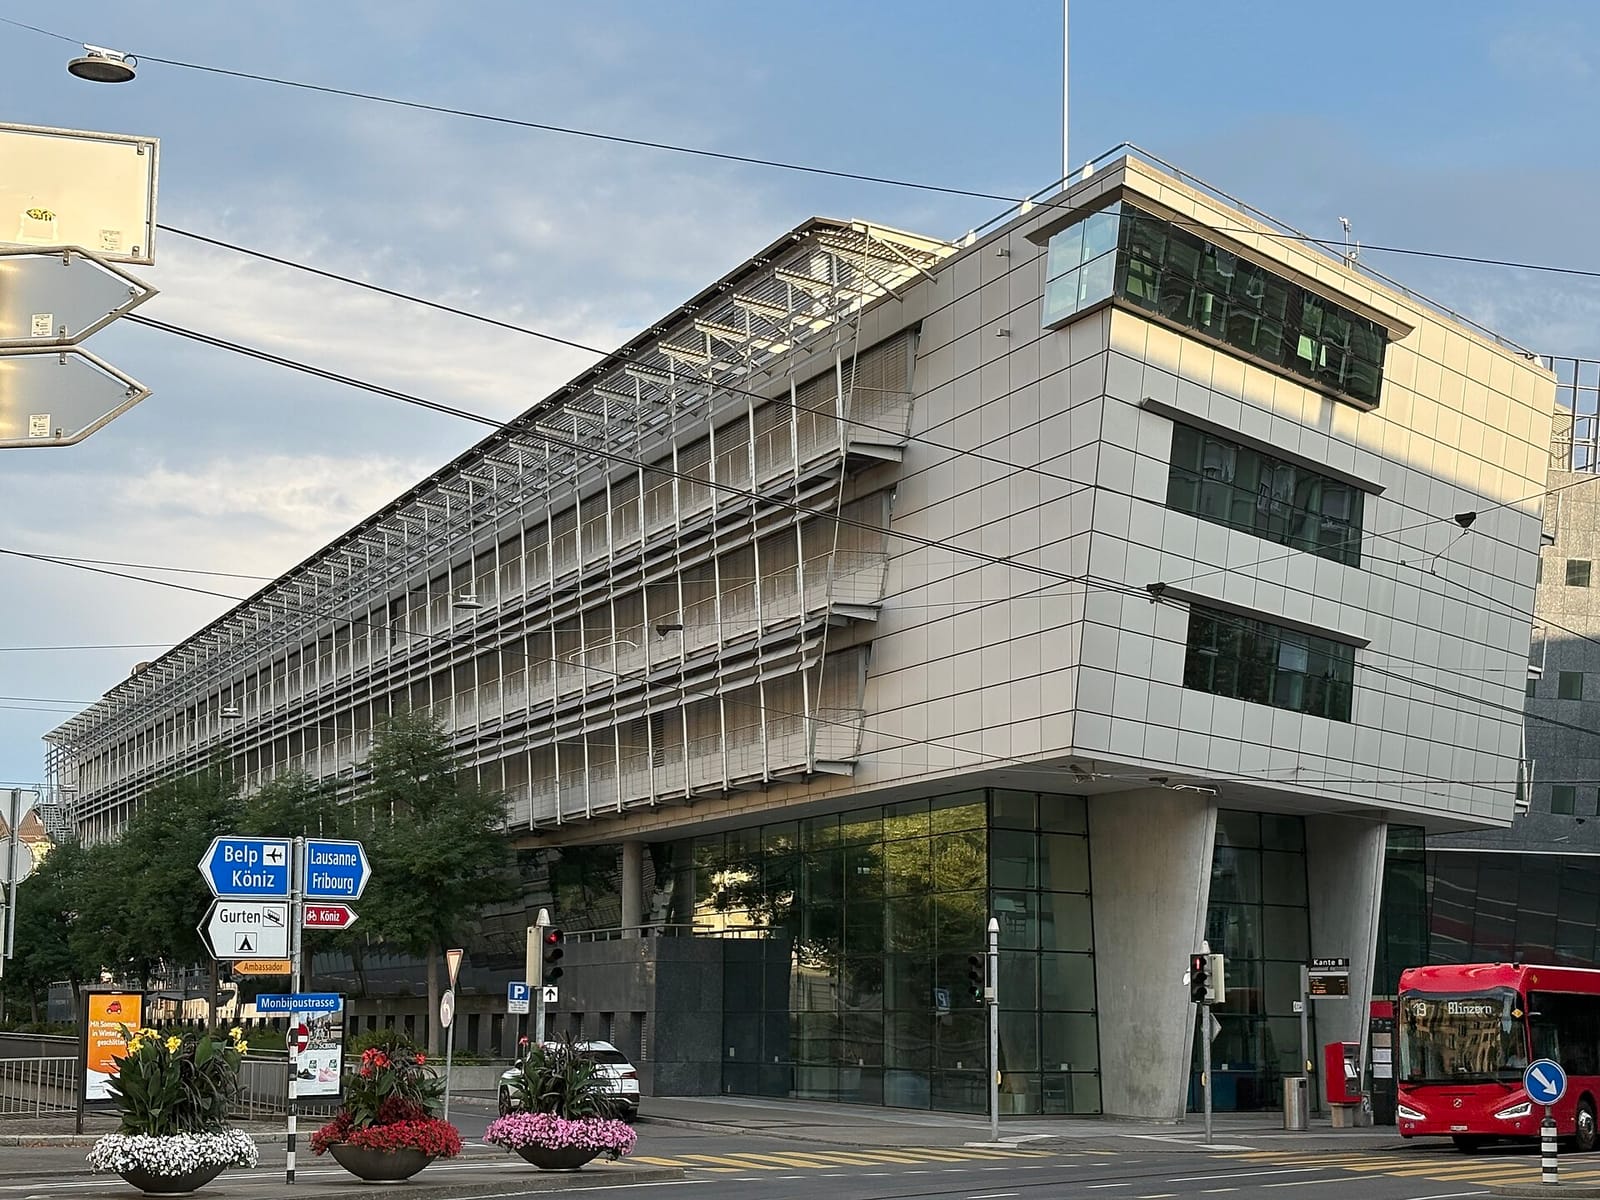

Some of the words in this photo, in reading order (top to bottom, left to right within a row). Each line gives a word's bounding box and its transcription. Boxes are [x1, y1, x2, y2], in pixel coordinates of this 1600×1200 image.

[224, 845, 258, 867] Belp
[311, 849, 357, 866] Lausanne
[232, 870, 275, 888] Köniz
[312, 873, 354, 893] Fribourg
[220, 909, 261, 923] Gurten
[320, 910, 340, 922] Köniz
[244, 963, 283, 971] Ambassador
[1313, 958, 1336, 966] Kante
[1338, 958, 1343, 966] B
[514, 985, 525, 999] P
[261, 997, 335, 1011] Monbijoustrasse
[1413, 1002, 1427, 1017] 19
[1448, 1001, 1492, 1015] Blinzern
